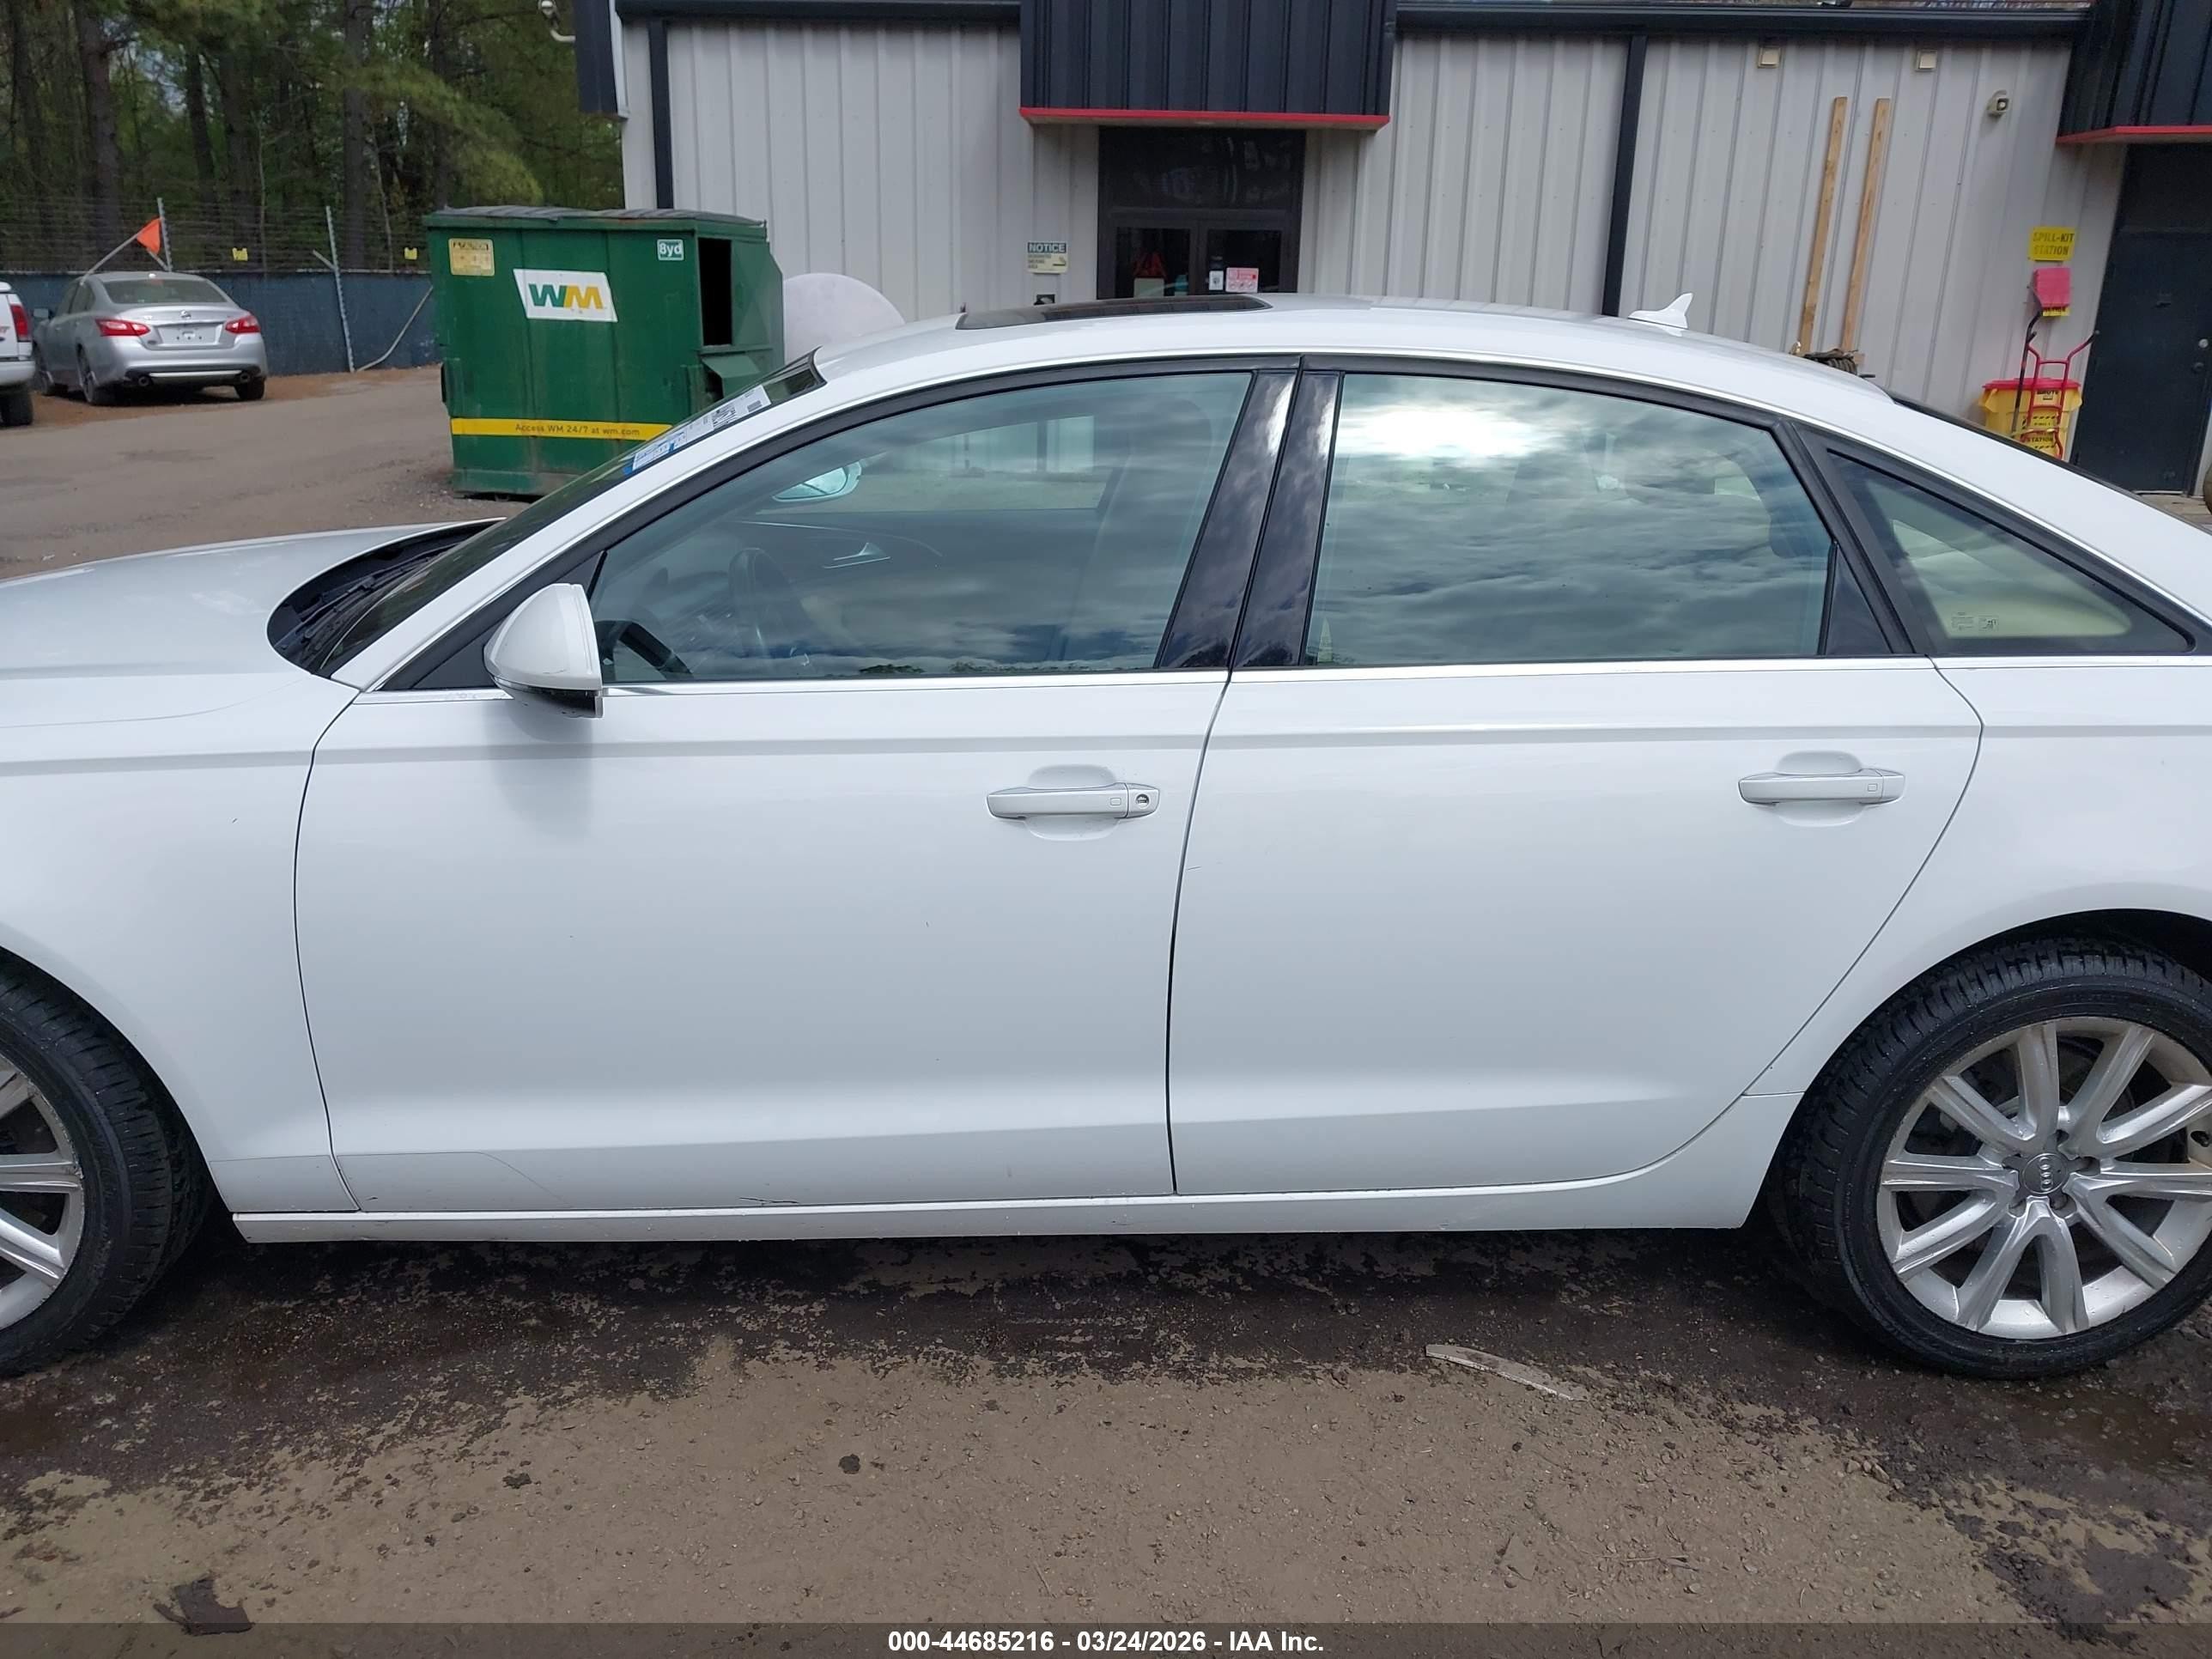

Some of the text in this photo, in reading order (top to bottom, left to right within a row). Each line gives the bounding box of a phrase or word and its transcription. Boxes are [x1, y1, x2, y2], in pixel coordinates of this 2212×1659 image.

[659, 242, 682, 257] 8yd
[1029, 243, 1066, 252] NOTICE
[2034, 246, 2069, 255] STATION
[528, 284, 604, 309] WM
[515, 423, 544, 432] Access
[567, 425, 588, 434] 24/7
